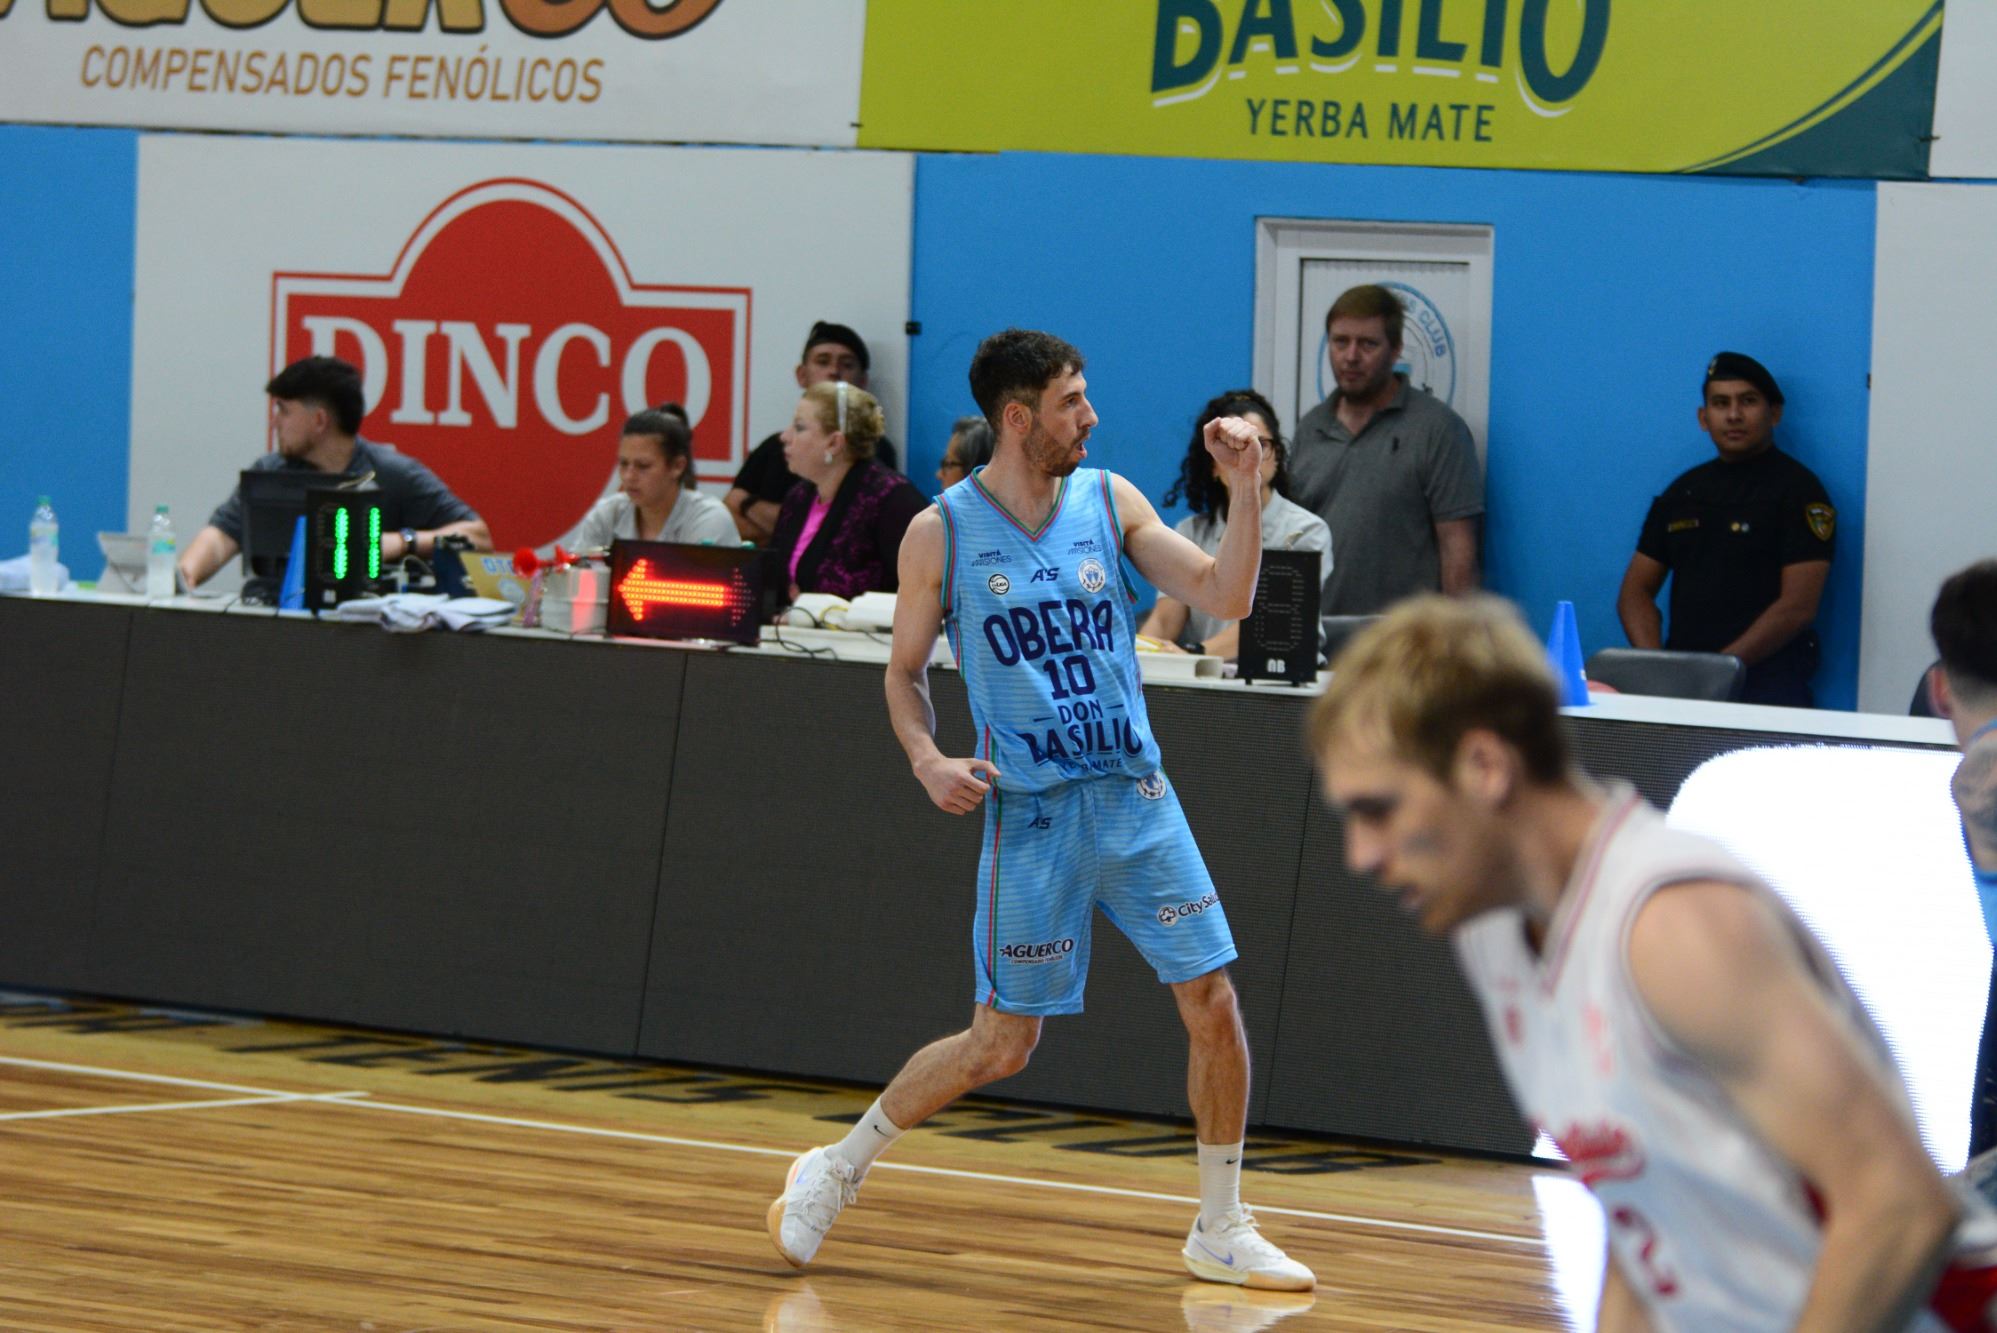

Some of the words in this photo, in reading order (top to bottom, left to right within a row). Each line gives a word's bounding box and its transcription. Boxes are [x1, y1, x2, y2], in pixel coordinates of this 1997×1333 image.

[80, 45, 373, 97] COMPENSADOS
[383, 44, 605, 103] FENÓLICOS
[1246, 97, 1369, 140] YERBA
[1388, 101, 1496, 142] MATE
[302, 314, 712, 437] DINCO
[1042, 654, 1096, 701] 10
[1057, 699, 1104, 725] DON
[1000, 938, 1074, 958] AGUERCO
